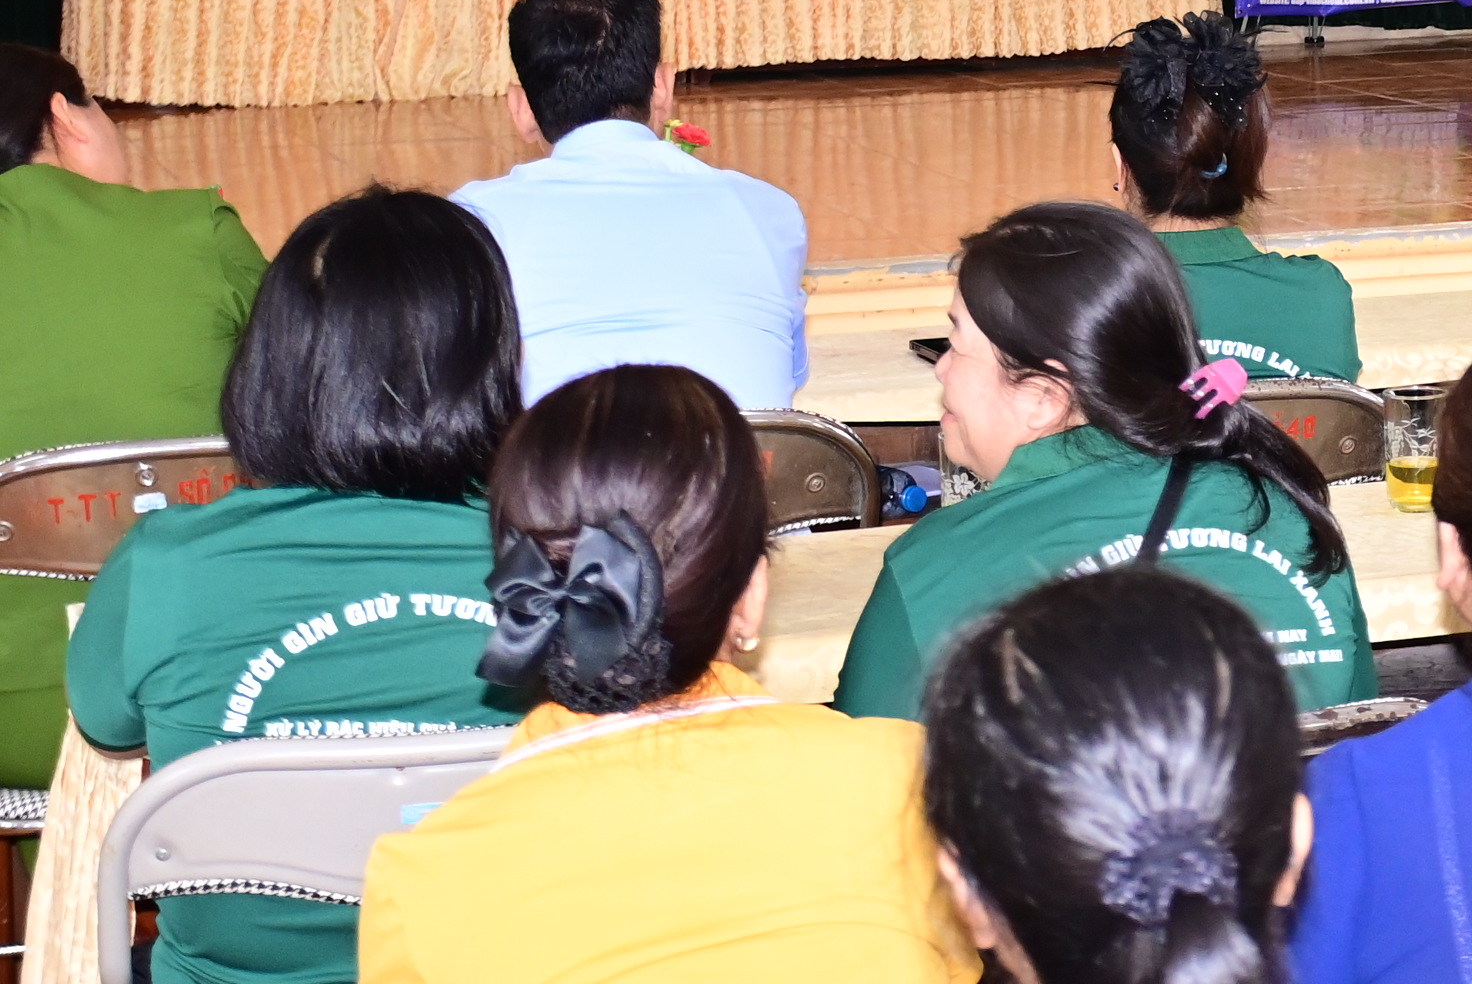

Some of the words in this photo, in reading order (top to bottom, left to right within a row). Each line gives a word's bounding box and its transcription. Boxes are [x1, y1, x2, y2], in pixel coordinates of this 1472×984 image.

[1267, 351, 1300, 377] LAI
[1252, 539, 1292, 575] LAI
[1290, 569, 1336, 637] XANH
[1277, 628, 1307, 643] NAY
[222, 647, 286, 734] NGƯỜI
[281, 612, 340, 654] GÌN
[343, 592, 400, 627] GIỮ
[408, 593, 498, 627] TƯƠN
[297, 718, 322, 736] LÝ
[326, 719, 364, 736] RÁC
